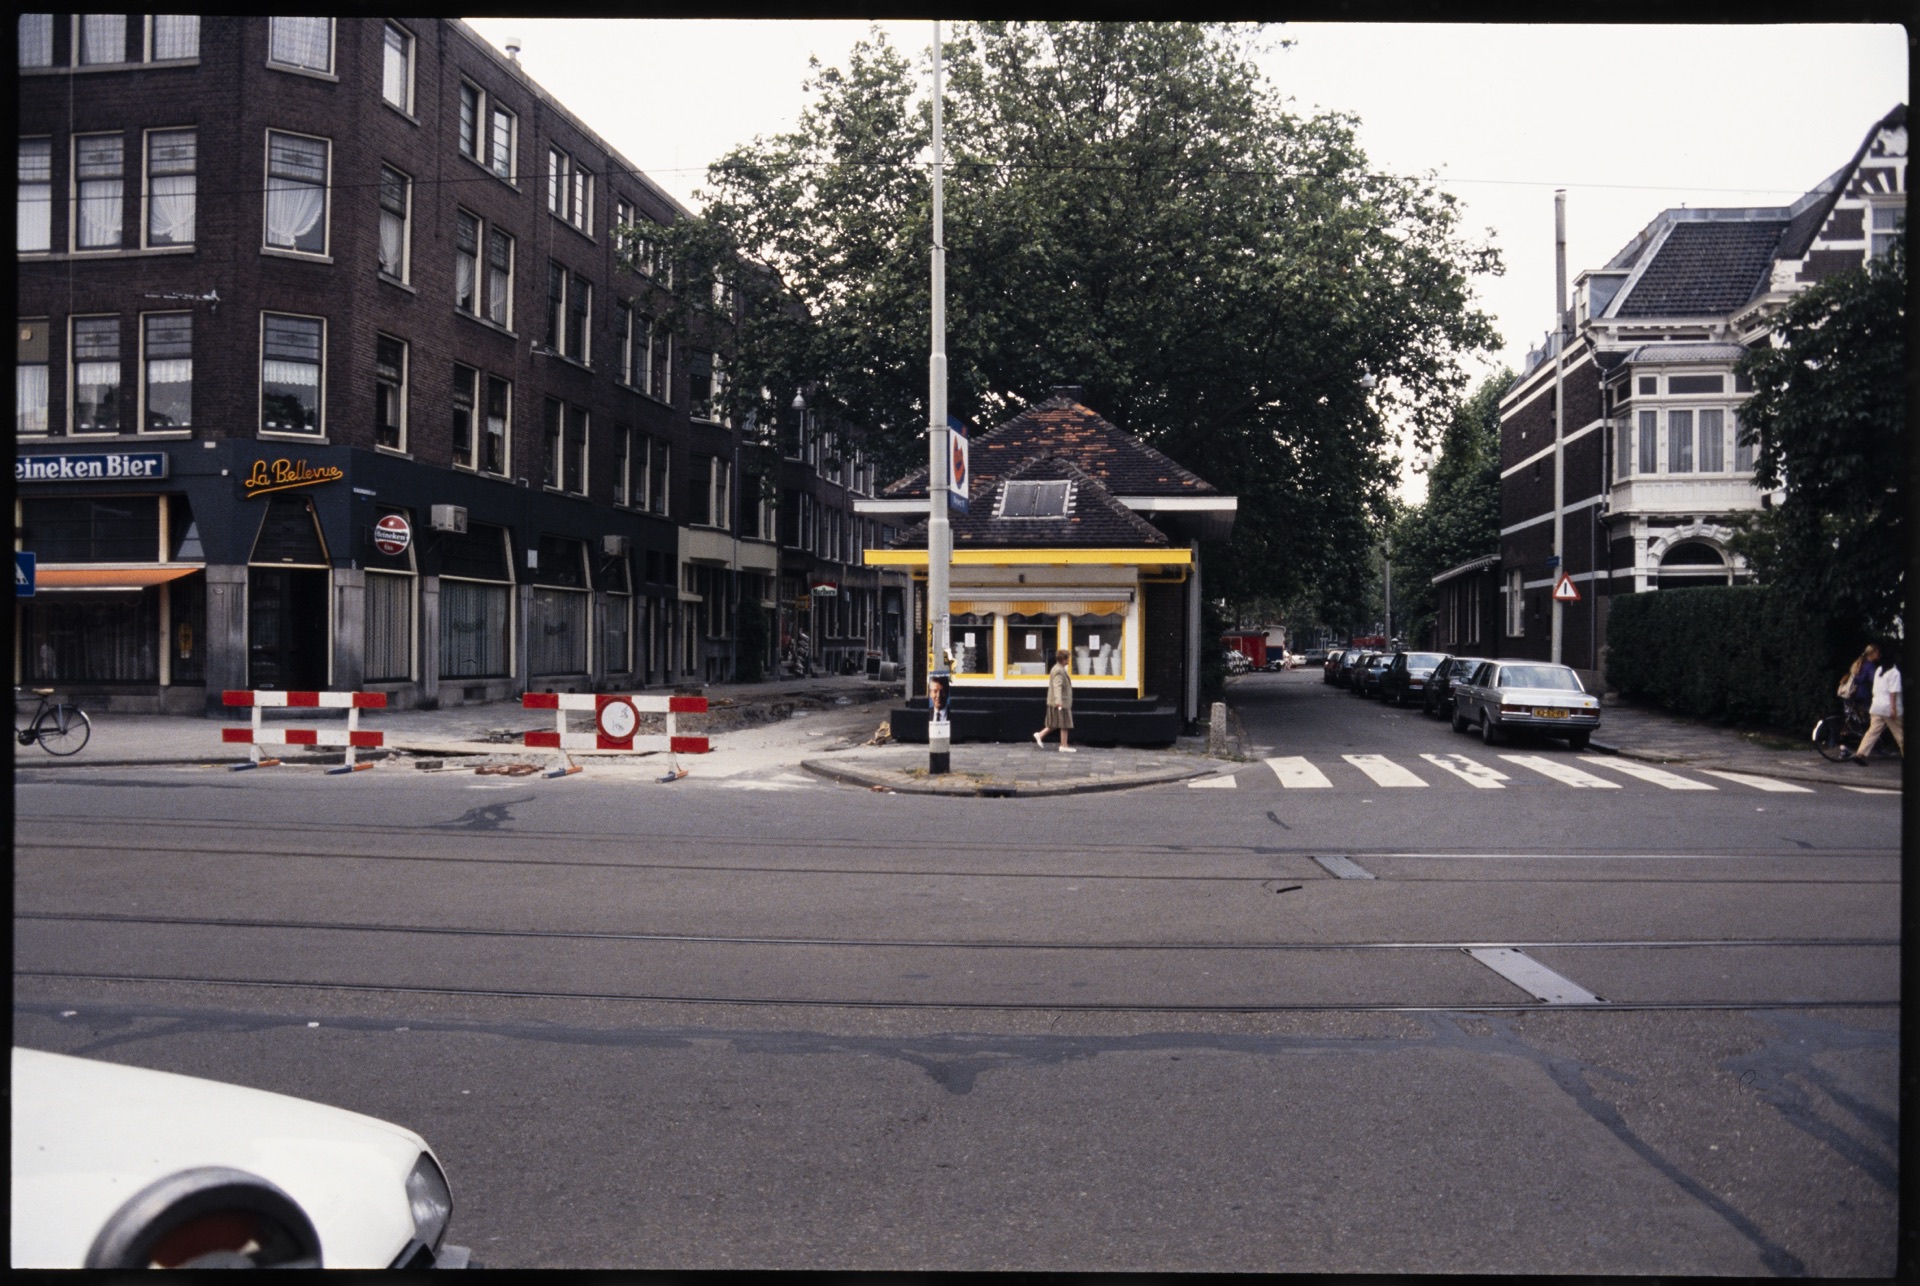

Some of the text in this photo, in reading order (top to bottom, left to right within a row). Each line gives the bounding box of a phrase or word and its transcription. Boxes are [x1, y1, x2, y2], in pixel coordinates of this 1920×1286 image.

[15, 455, 157, 479] eineken Bier
[245, 458, 342, 488] La Bellevue
[376, 529, 406, 541] Heineken
